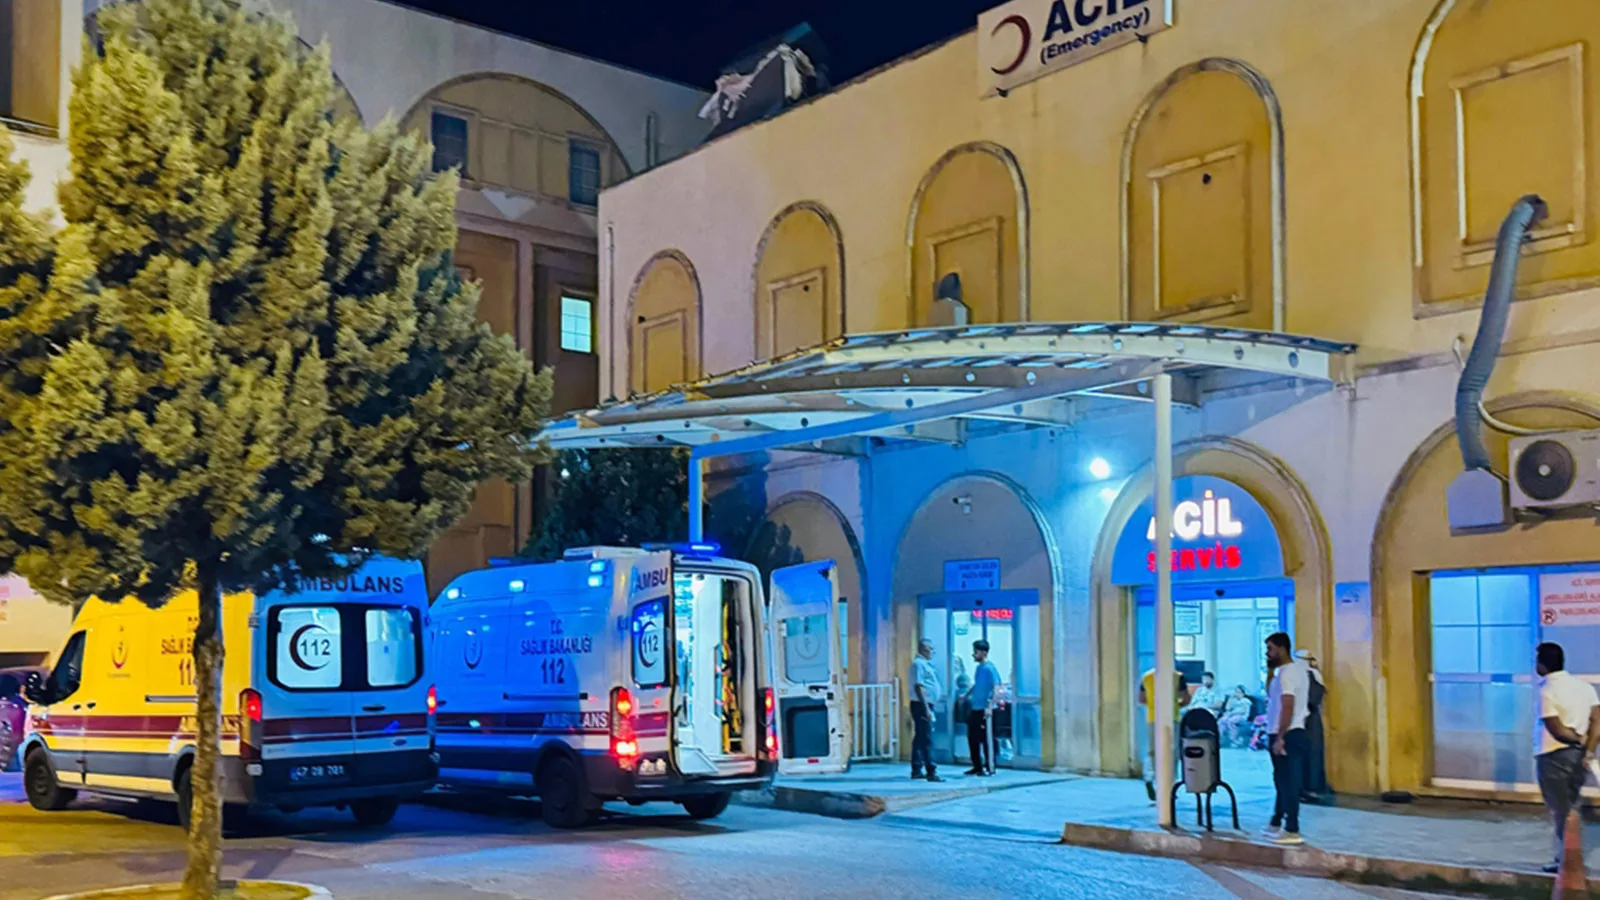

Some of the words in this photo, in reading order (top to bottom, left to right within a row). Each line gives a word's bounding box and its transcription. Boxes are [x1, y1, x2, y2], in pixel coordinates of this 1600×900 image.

[1041, 0, 1149, 41] AC
[1040, 6, 1150, 65] (Emergency)
[293, 576, 404, 593] MBULANS
[300, 639, 331, 656] 112
[643, 633, 659, 653] 112
[179, 658, 198, 686] 11
[541, 658, 565, 684] 112
